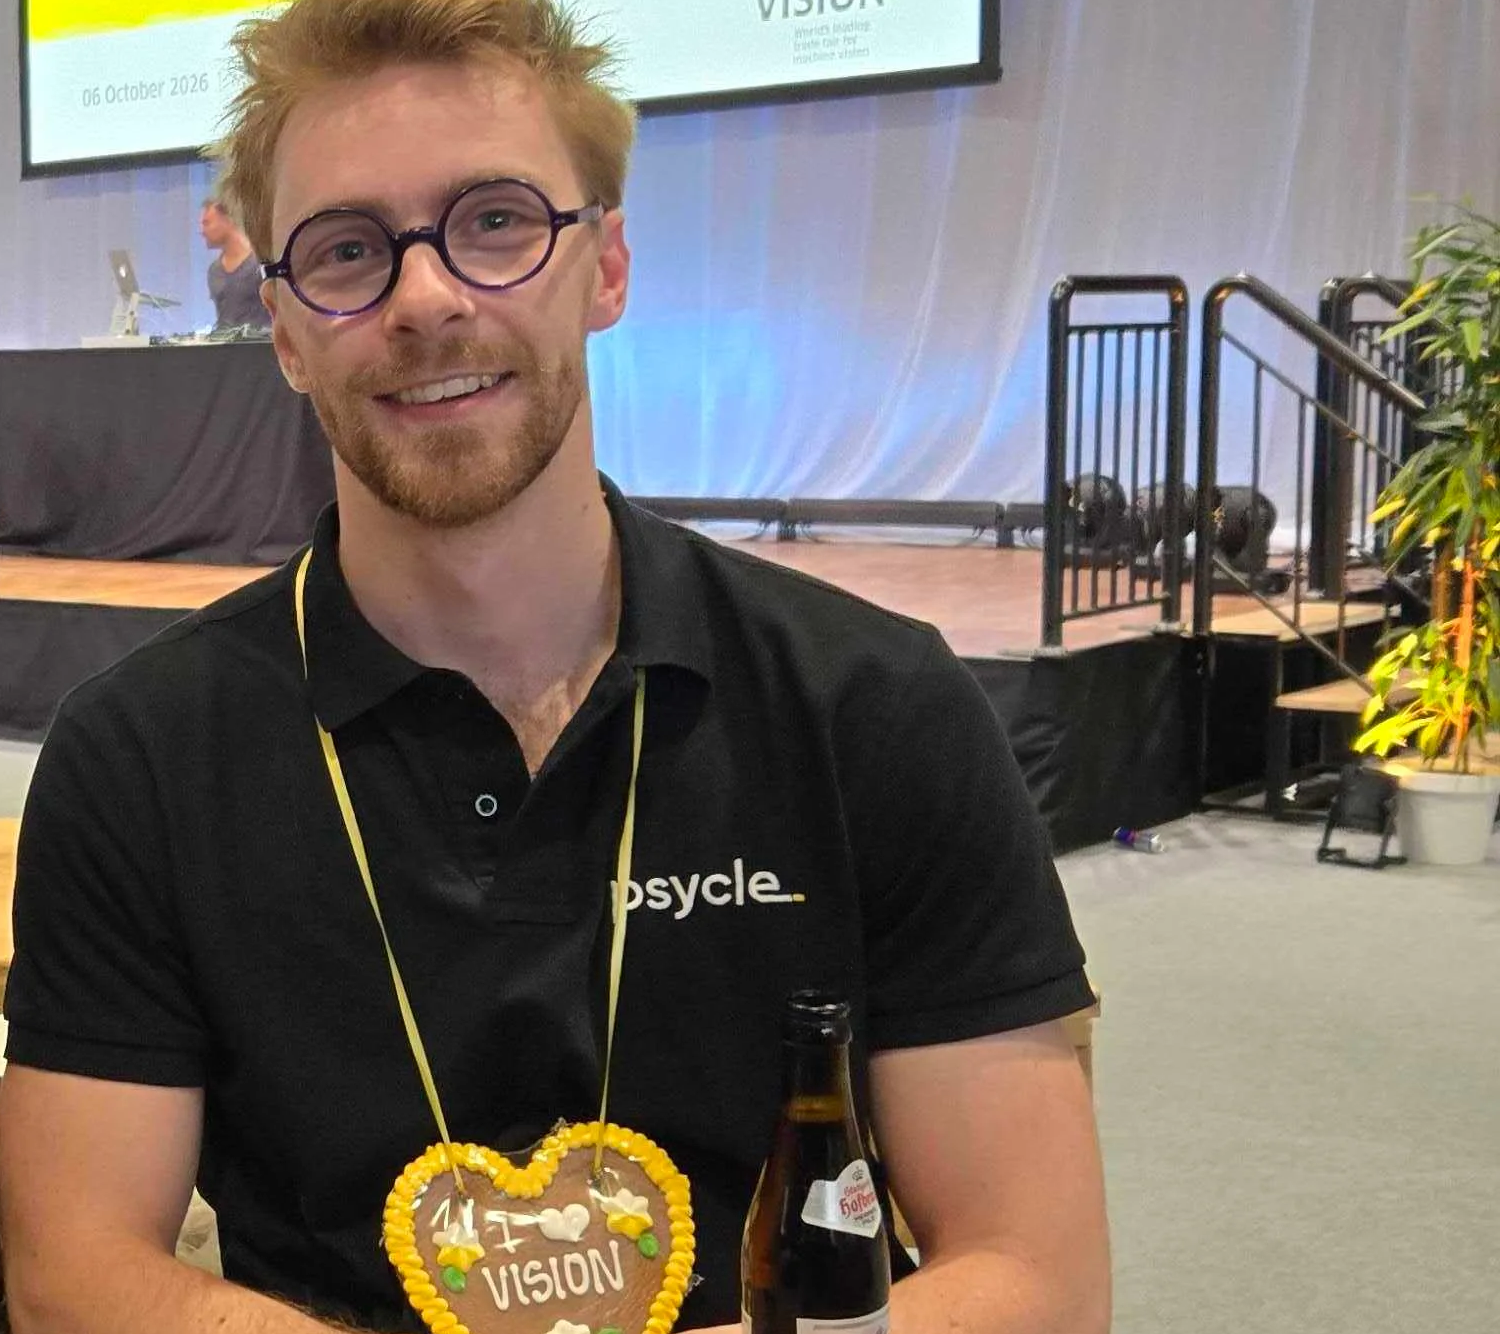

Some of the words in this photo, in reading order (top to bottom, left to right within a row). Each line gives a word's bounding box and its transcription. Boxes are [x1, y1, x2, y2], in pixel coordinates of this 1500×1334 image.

[82, 87, 101, 107] 06
[105, 78, 165, 104] October
[170, 72, 209, 97] 2026
[481, 1239, 624, 1311] VISION
